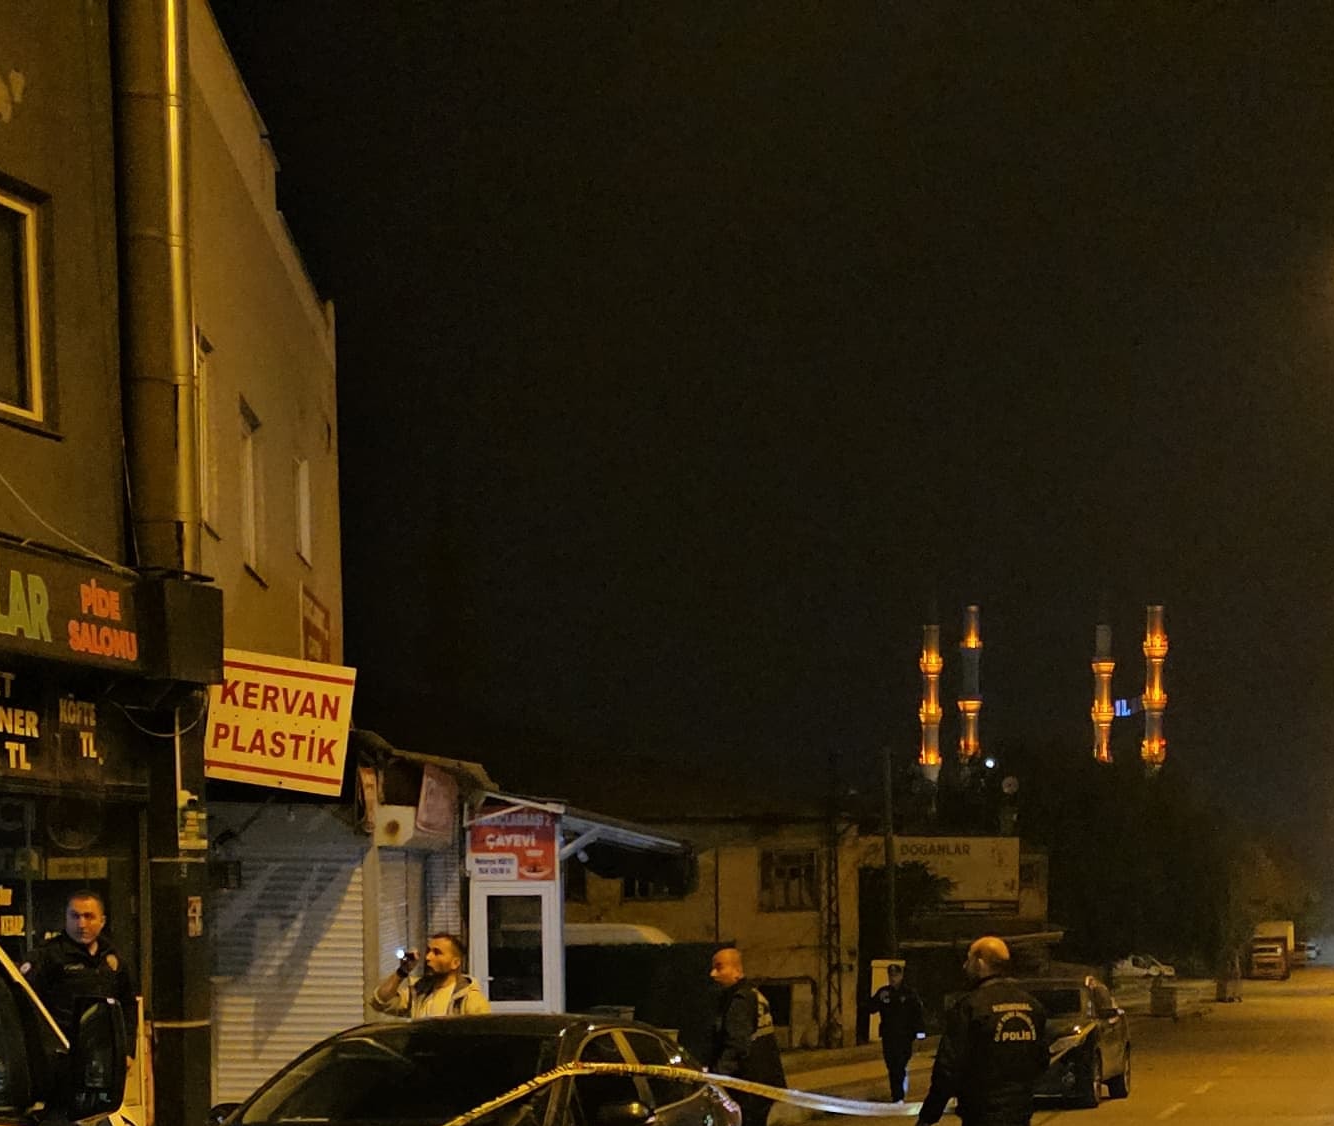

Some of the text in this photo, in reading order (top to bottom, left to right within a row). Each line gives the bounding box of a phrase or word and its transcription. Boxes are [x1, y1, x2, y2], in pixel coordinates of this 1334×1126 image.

[80, 578, 122, 621] PİDE
[68, 619, 138, 662] SALONU
[220, 678, 341, 723] KERVAN
[5, 741, 32, 770] TL
[80, 731, 98, 759] TL
[212, 722, 339, 766] PLASTİK
[1003, 1029, 1032, 1042] POLİS
